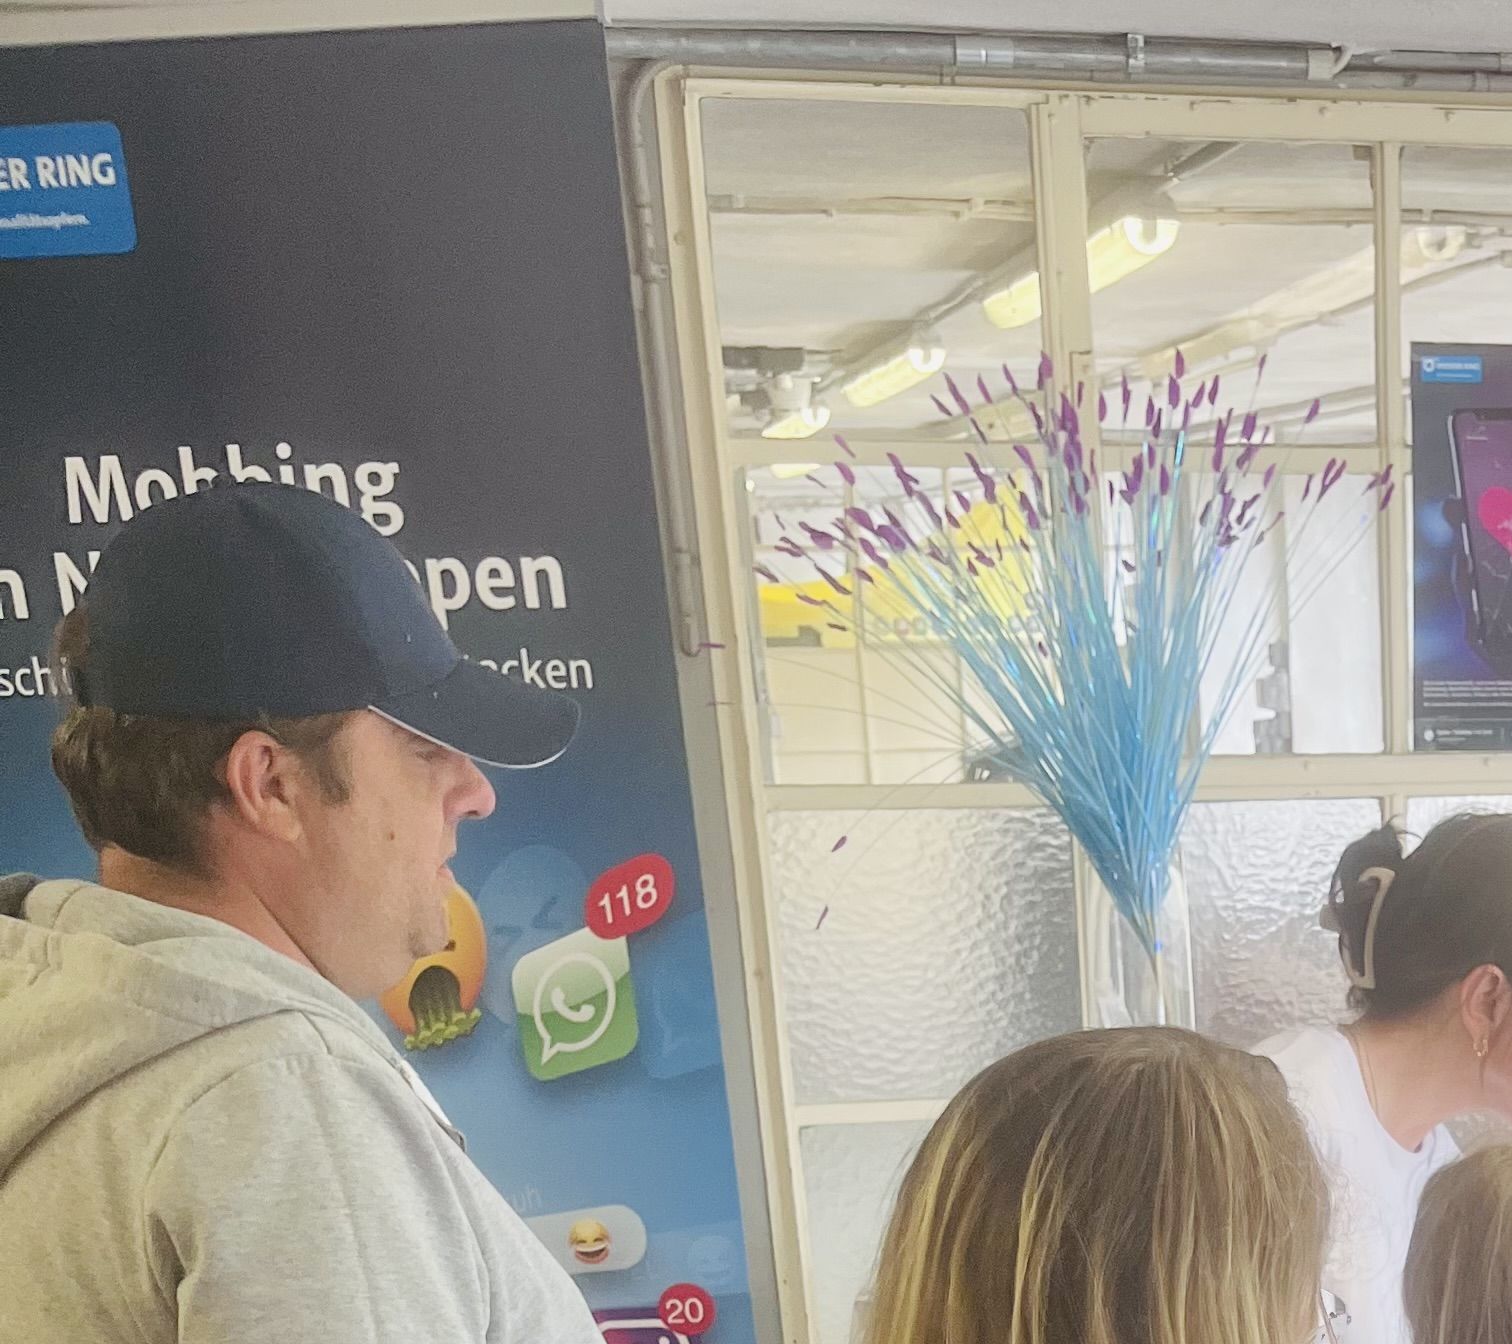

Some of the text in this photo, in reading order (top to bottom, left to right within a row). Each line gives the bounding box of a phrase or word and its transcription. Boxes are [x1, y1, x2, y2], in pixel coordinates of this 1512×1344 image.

[35, 152, 117, 189] RING
[597, 873, 658, 924] 118
[665, 1297, 704, 1325] 20
